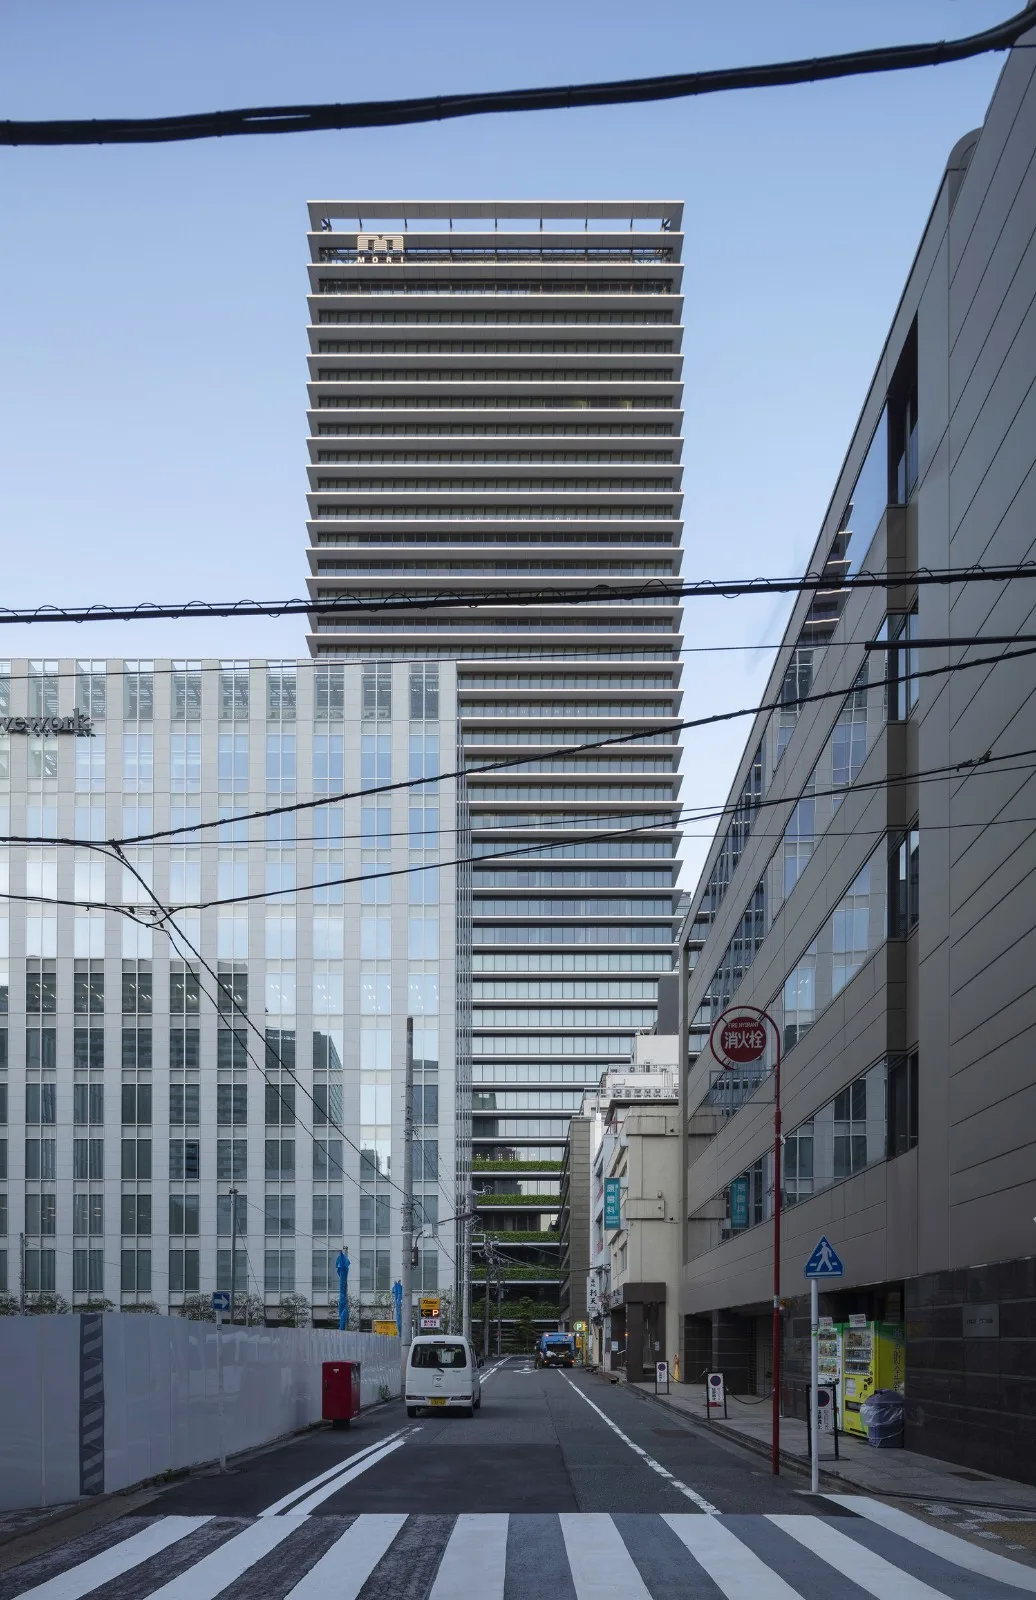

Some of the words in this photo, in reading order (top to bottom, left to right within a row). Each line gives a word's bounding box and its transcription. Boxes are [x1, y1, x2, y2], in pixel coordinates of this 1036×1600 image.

[357, 256, 404, 264] MORI
[725, 1030, 763, 1049] 消火栓
[432, 1309, 439, 1317] P
